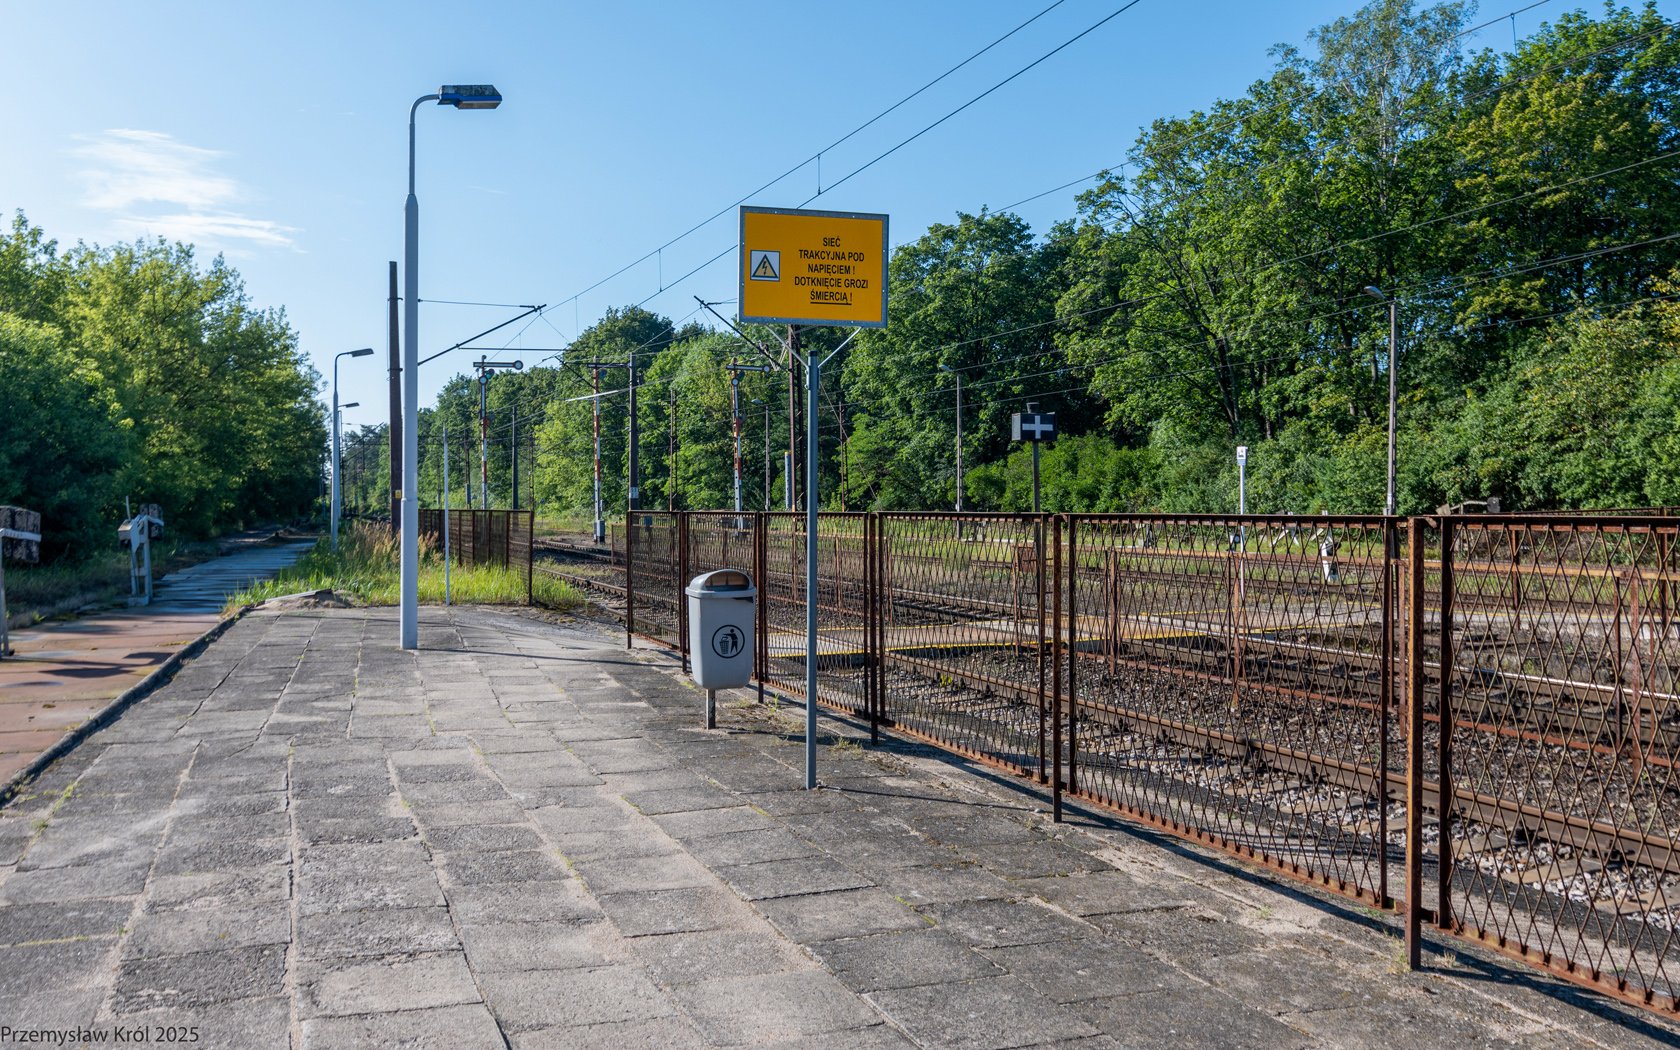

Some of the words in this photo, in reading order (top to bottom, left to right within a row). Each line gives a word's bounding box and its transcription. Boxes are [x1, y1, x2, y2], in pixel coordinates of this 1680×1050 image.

[822, 236, 841, 247] SIEĆ
[799, 249, 846, 261] TRAKCYJNA
[848, 252, 865, 262] POD
[808, 264, 851, 276] NAPIĘCIEM
[794, 276, 842, 289] DOTKNIĘCIE
[844, 279, 869, 289] GROZI
[810, 289, 848, 303] ŚMIERCIĄ
